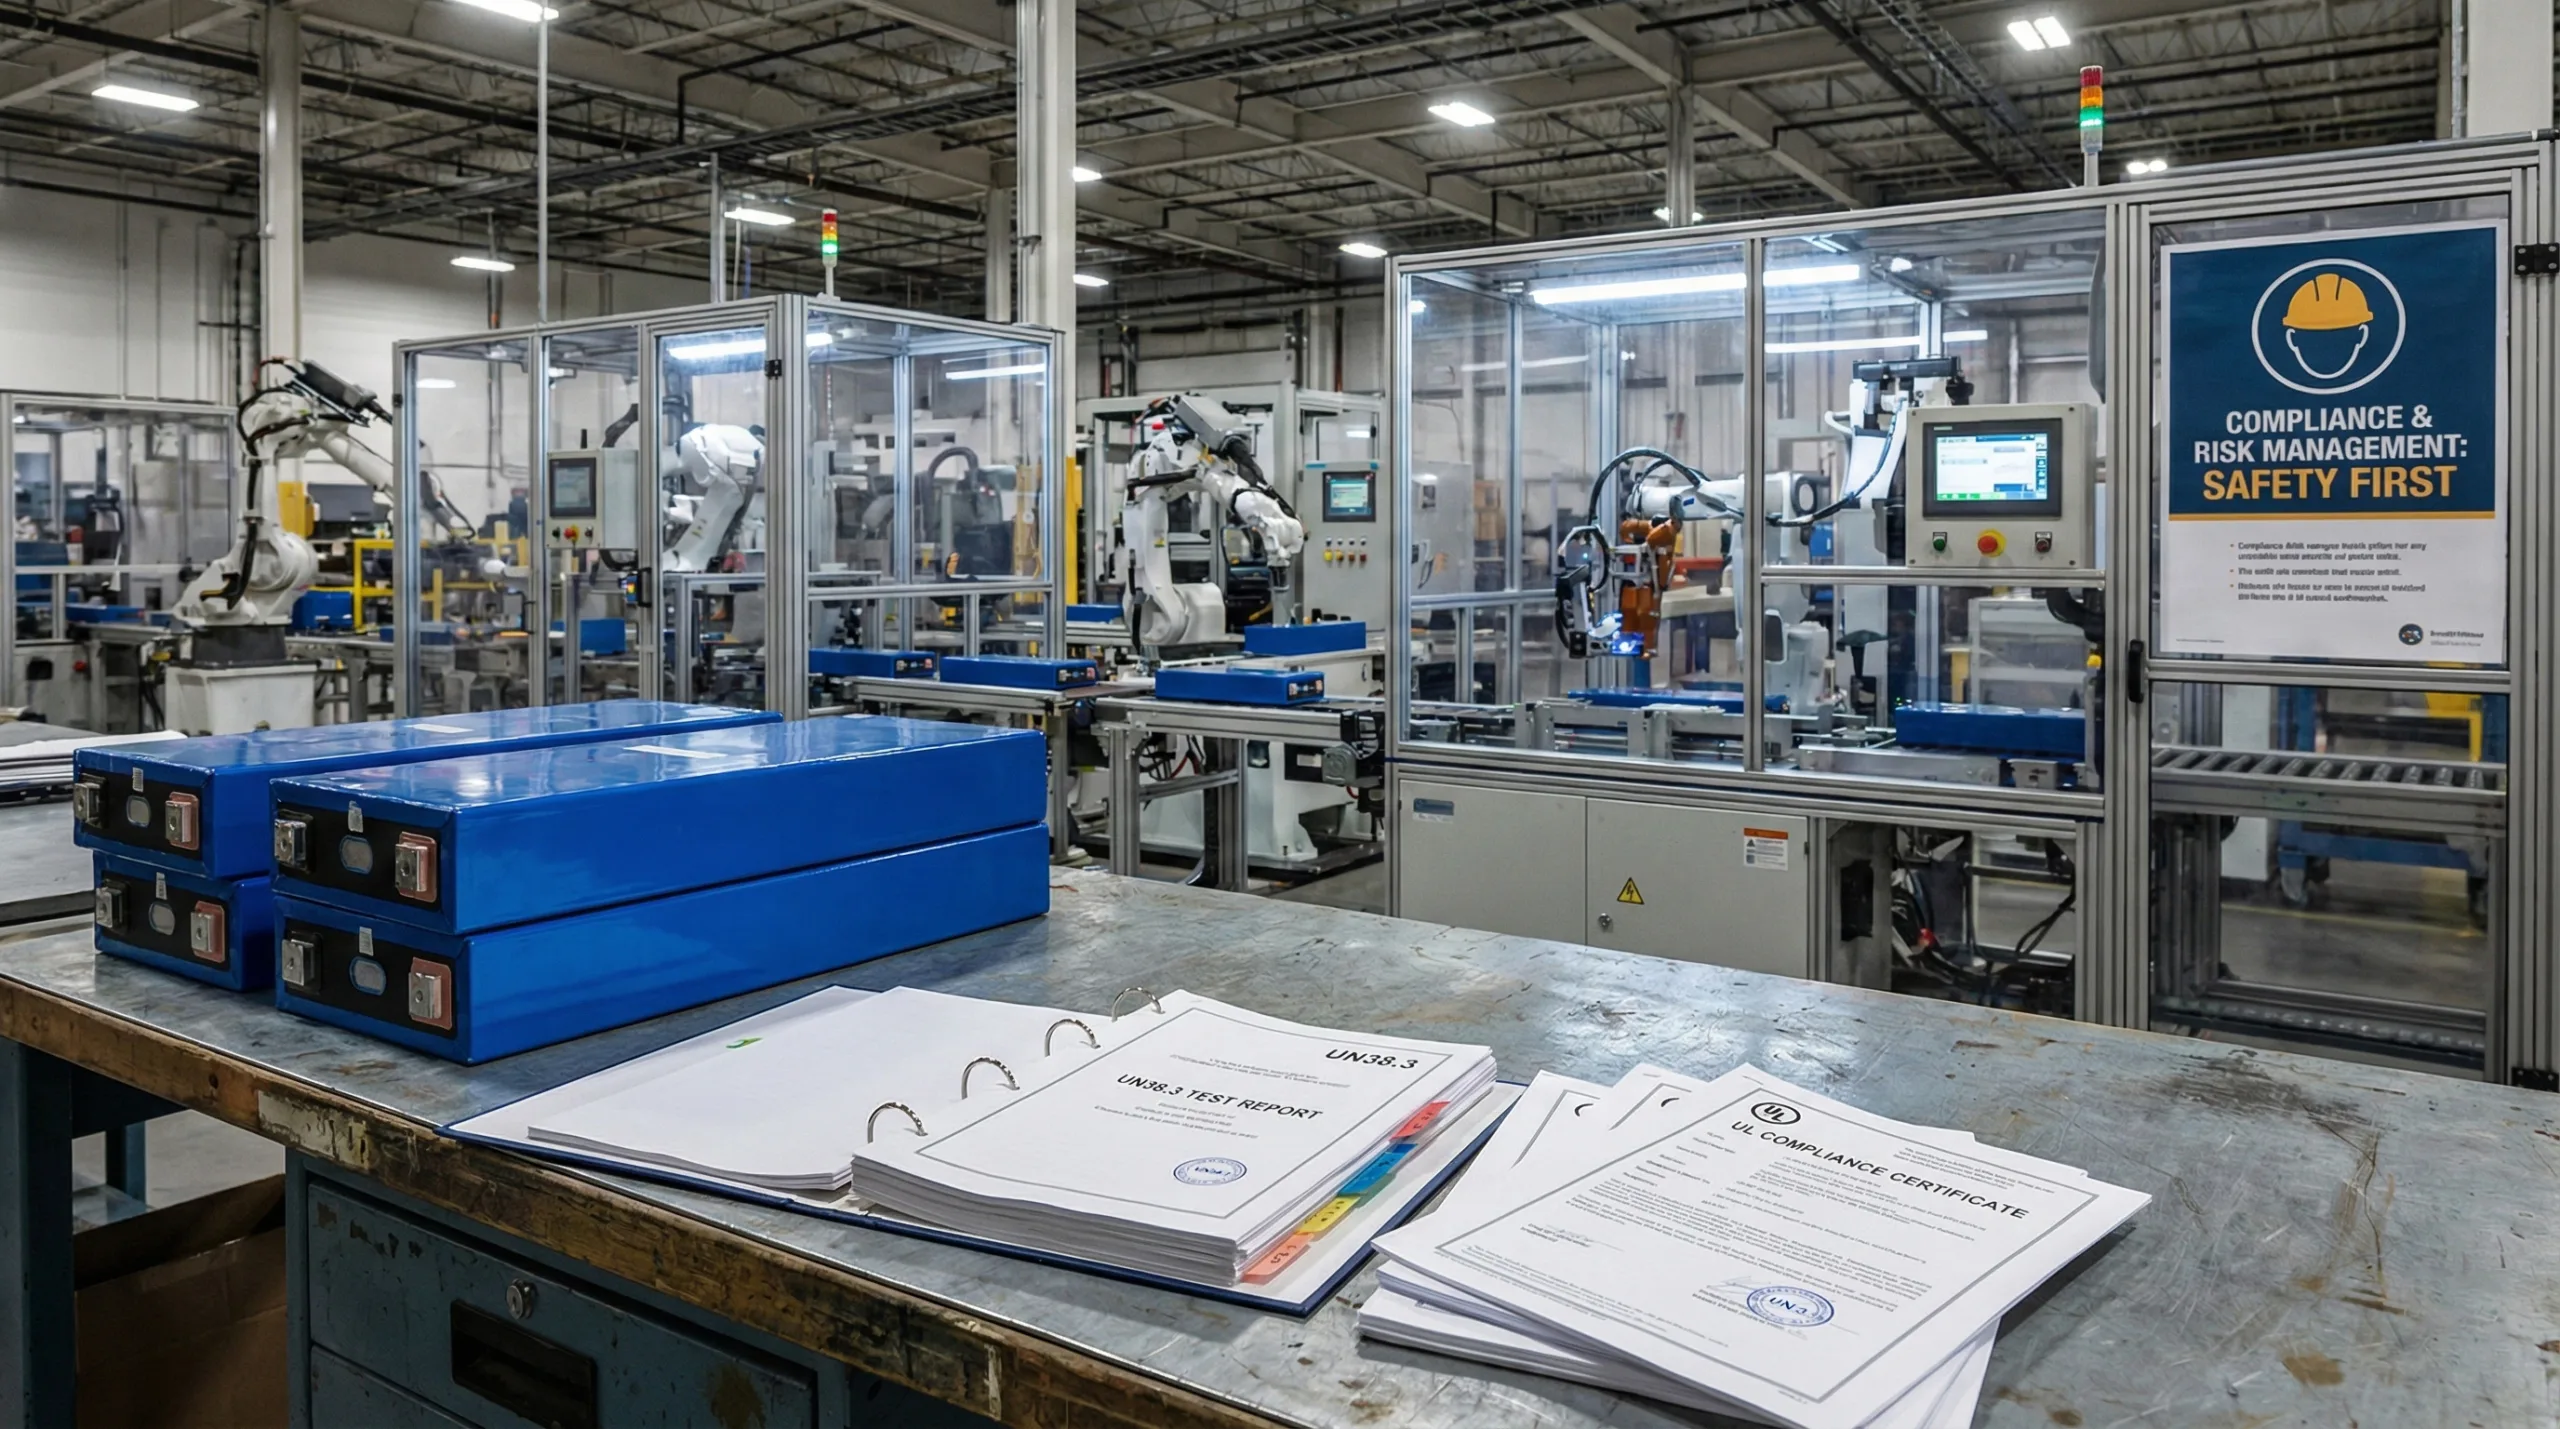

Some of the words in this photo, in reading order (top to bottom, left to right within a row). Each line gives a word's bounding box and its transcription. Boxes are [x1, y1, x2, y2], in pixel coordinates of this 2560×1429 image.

[2226, 405, 2403, 434] COMPLIANCE
[2411, 404, 2433, 428] &
[2194, 440, 2255, 464] RISK
[2262, 434, 2468, 462] MANAGEMENT:
[2203, 467, 2338, 500] SAFETY
[2350, 465, 2458, 498] FIRST
[1325, 1049, 1418, 1069] UN38.3
[1116, 1073, 1184, 1096] UN38.3
[1186, 1089, 1239, 1106] TEST
[1237, 1098, 1324, 1120] REPORT
[1763, 1105, 1786, 1122] UL
[1731, 1121, 1755, 1136] UL
[1760, 1131, 1889, 1177] COMPLIANCE
[1889, 1172, 2030, 1219] CERTIFICATE
